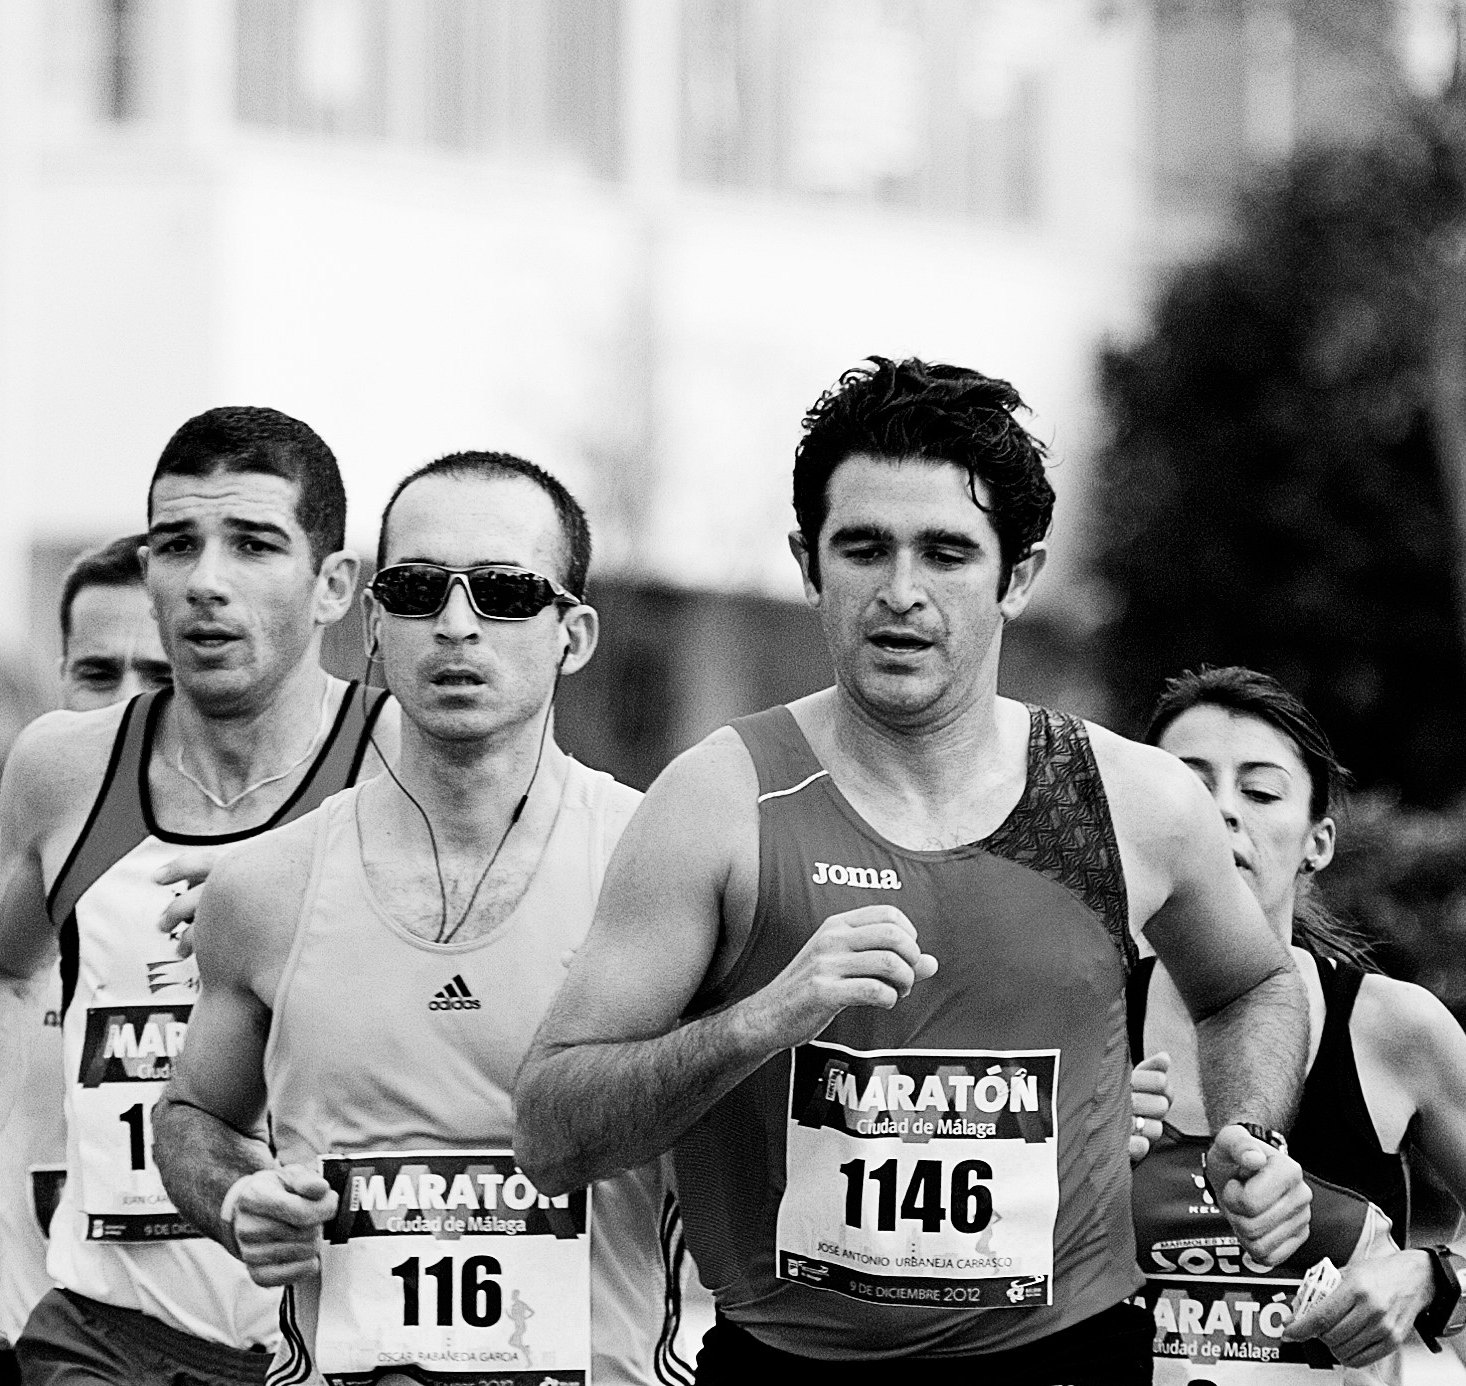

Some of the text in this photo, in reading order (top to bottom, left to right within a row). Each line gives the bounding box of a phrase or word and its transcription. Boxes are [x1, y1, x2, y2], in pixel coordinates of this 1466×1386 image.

[812, 862, 902, 890] Joma
[428, 997, 482, 1011] adidas
[138, 1064, 172, 1079] Ciud
[826, 1064, 1039, 1113] MARATÓN
[856, 1117, 997, 1138] Ciudad de Málaga
[839, 1158, 993, 1234] 1146
[1188, 1205, 1220, 1214] KEL
[387, 1216, 527, 1235] Ciudad de Málaga
[842, 1249, 890, 1266] ANTONIO
[895, 1257, 955, 1268] URBANEJA
[956, 1257, 1013, 1269] CARRASCO
[391, 1255, 502, 1328] 116
[849, 1280, 981, 1302] 9 DE DICIEMBRE 2012
[1153, 1291, 1296, 1338] ARATÓ
[1201, 1340, 1221, 1357] de
[1224, 1342, 1280, 1362] Málaga
